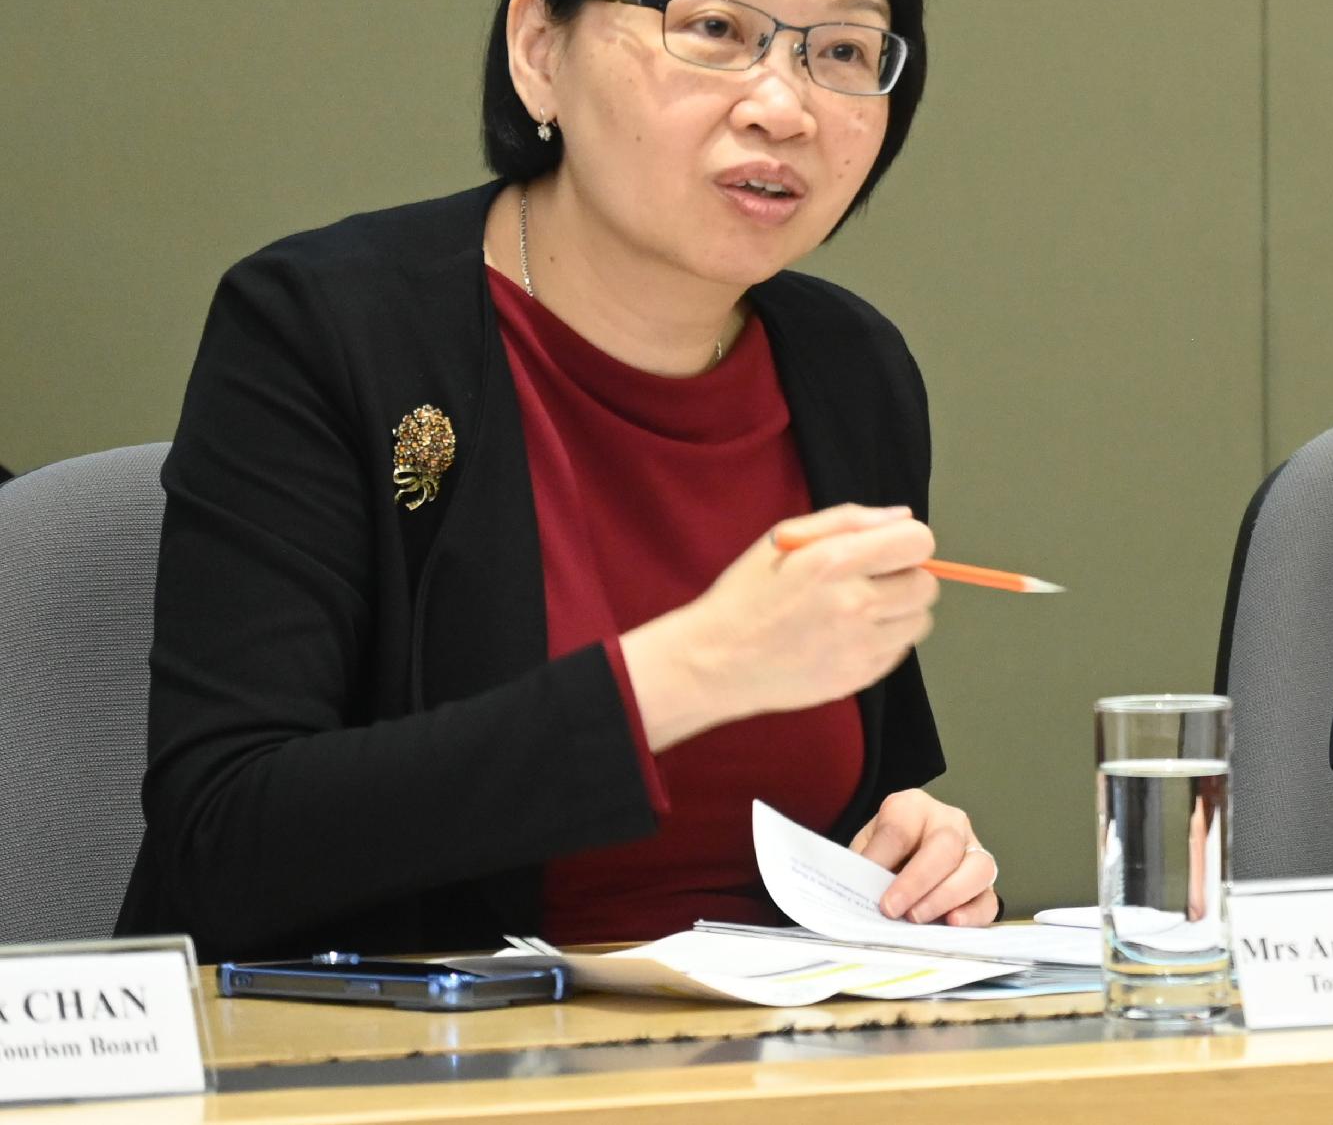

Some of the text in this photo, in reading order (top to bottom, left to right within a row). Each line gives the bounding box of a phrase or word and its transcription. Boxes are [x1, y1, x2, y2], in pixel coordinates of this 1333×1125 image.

[1240, 936, 1300, 962] Mrs
[23, 986, 149, 1023] CHAN
[0, 1034, 159, 1060] ourism Board
